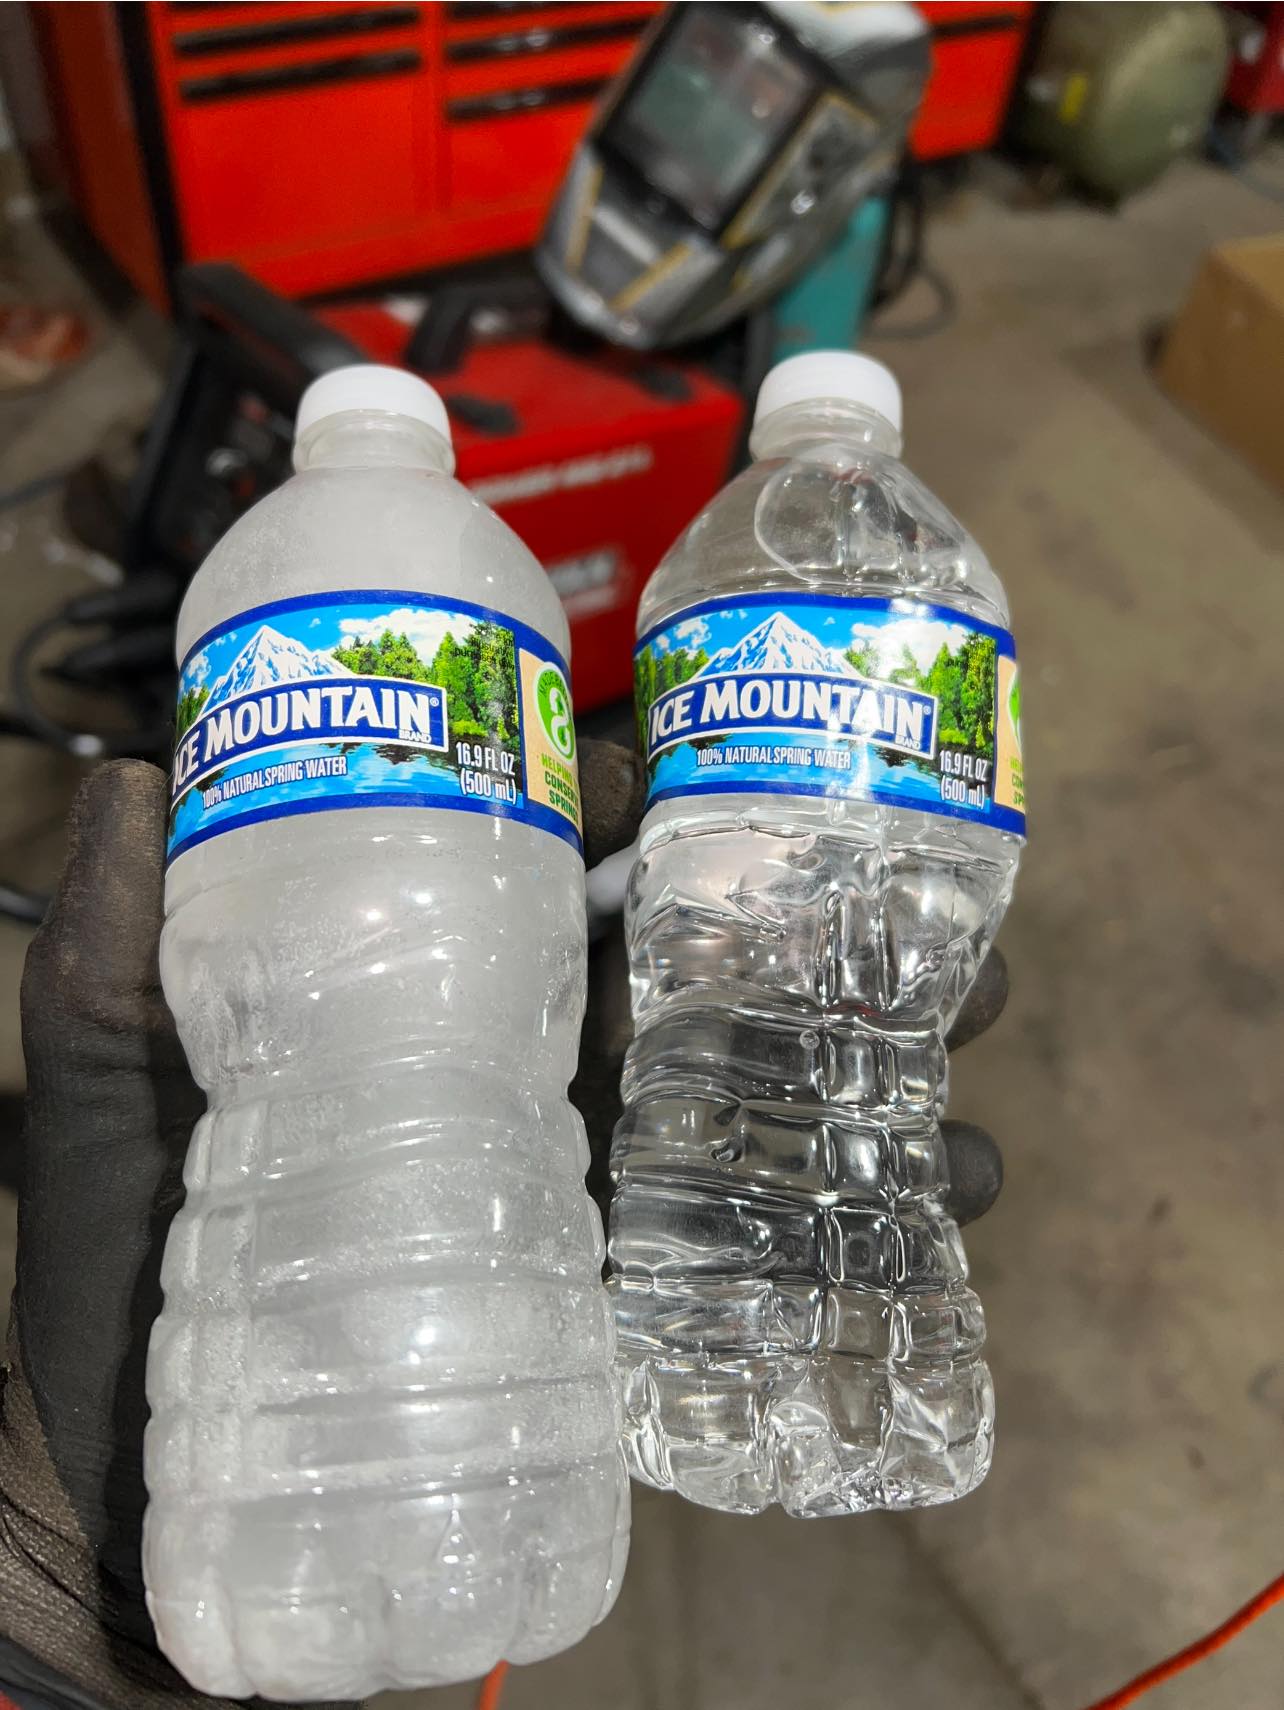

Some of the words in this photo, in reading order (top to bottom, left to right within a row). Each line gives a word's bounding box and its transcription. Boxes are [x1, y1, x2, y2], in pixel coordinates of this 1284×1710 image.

[203, 687, 430, 763] MOUNTAIN
[399, 729, 432, 743] BRAND
[651, 690, 695, 746] ICE
[456, 741, 482, 768] 16.9
[484, 746, 499, 771] FL
[500, 750, 516, 776] OZ
[697, 748, 723, 767] 100%
[724, 746, 773, 765] NATURAL
[773, 746, 812, 767] SPRING
[813, 749, 852, 770] WATER
[939, 749, 961, 775] 16.9
[962, 754, 974, 778] FL
[975, 757, 988, 783] OZ
[202, 784, 223, 809] 100%
[222, 769, 266, 801] NATURAL
[264, 760, 304, 788] SPRING
[305, 755, 348, 779] WATER
[460, 767, 492, 797] (500
[494, 778, 517, 806] mL)
[940, 774, 966, 802] (500
[967, 784, 985, 810] mL)
